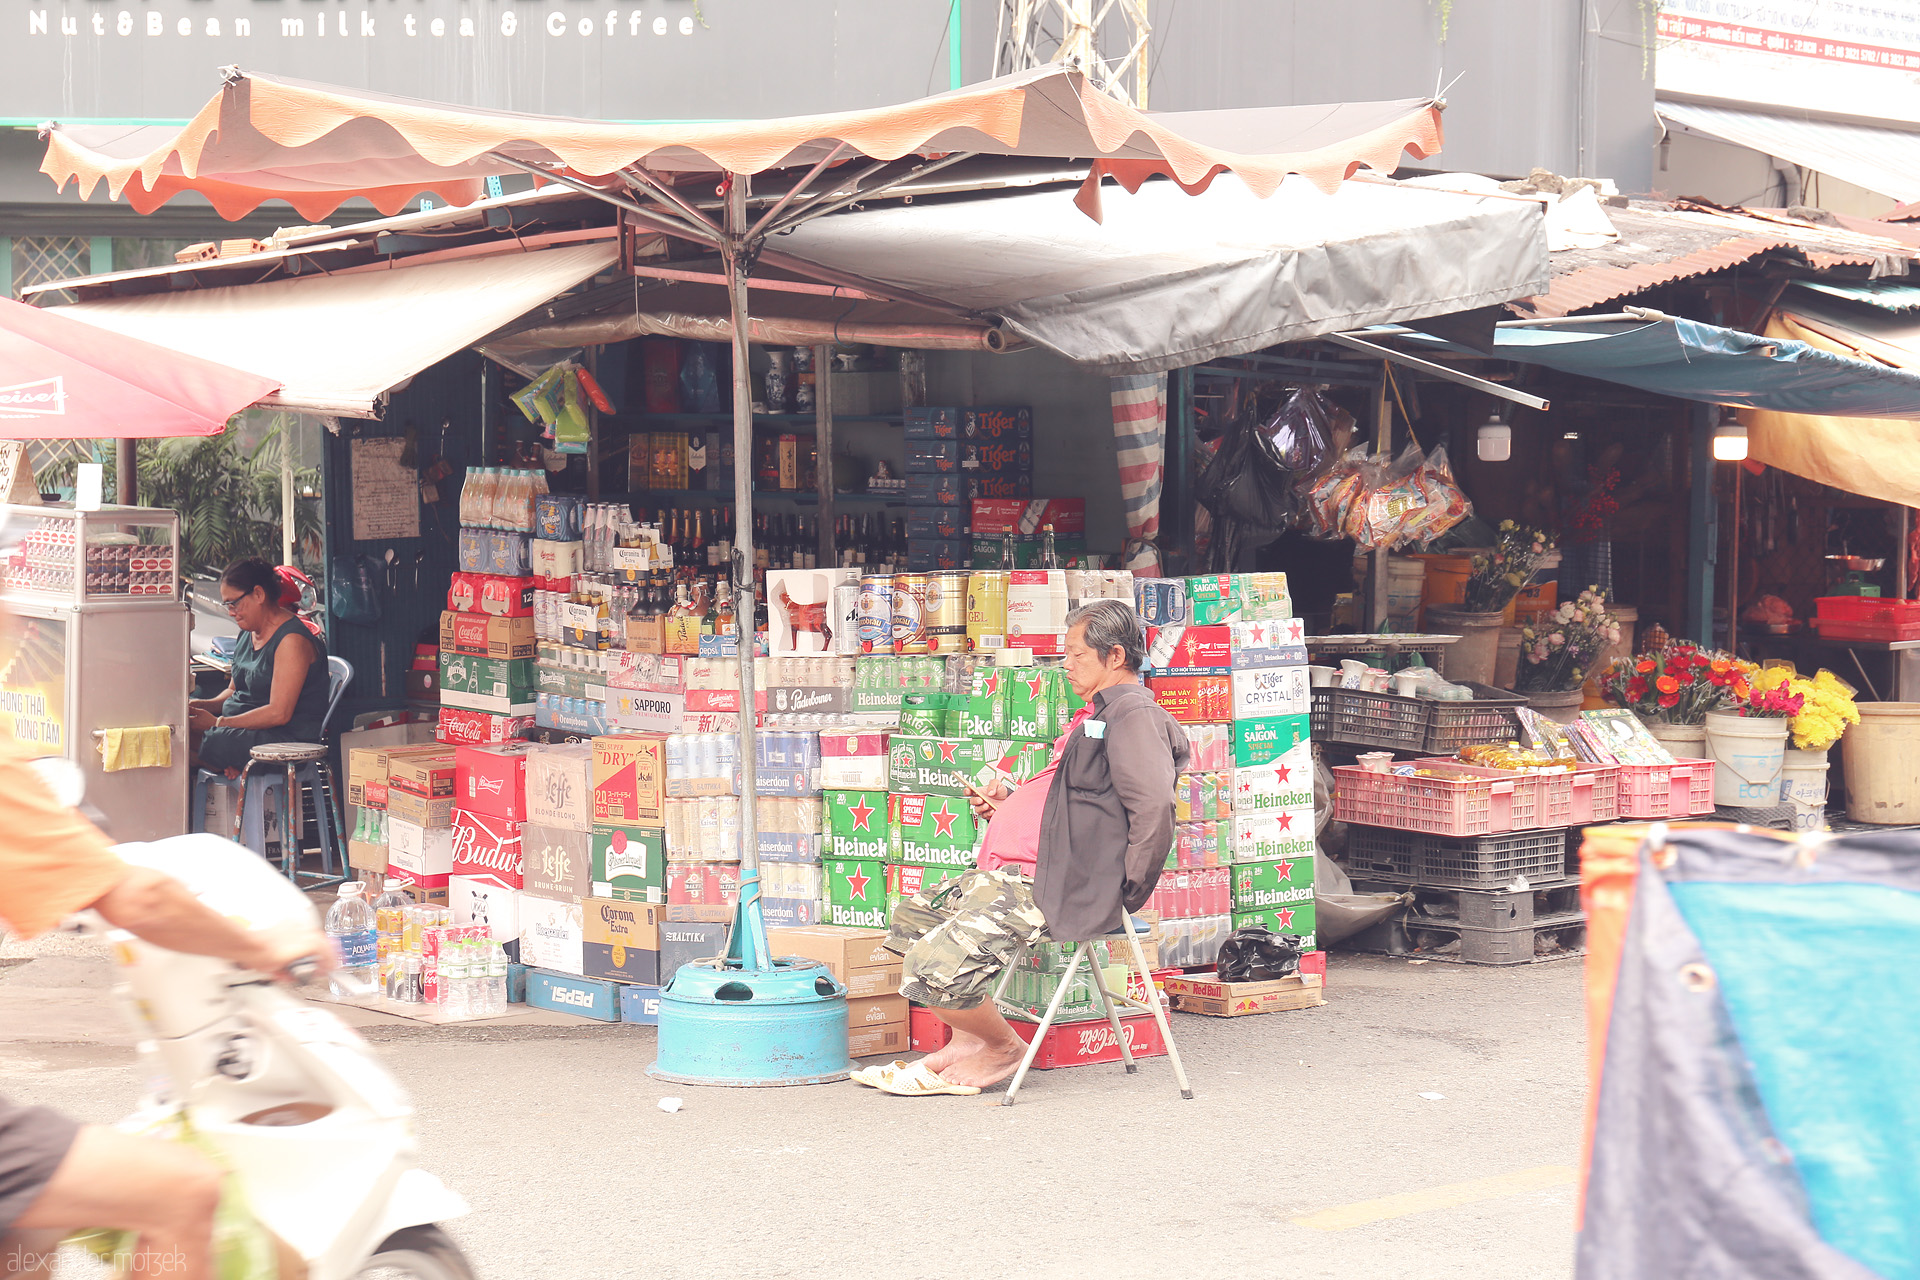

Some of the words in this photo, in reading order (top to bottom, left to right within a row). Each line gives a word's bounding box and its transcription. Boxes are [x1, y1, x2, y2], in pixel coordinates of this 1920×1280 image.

[29, 10, 251, 36] Nut&Bean
[281, 11, 376, 37] milk
[405, 12, 476, 37] tea
[500, 12, 518, 37] &
[546, 12, 694, 37] Coffee
[978, 411, 1015, 437] Tiger
[934, 425, 952, 437] Tiger
[979, 444, 1016, 471] Tiger
[936, 459, 954, 471] Tiger
[981, 477, 1017, 497] Tiger
[937, 492, 956, 504] Tiger
[973, 545, 997, 554] SAIGON
[1193, 583, 1218, 593] SAIGON
[458, 625, 484, 641] Coca-Cola
[700, 646, 718, 656] pepsi
[1262, 672, 1283, 688] Tiger
[1246, 690, 1291, 704] CRYSTAL
[634, 698, 671, 714] SAPPORO
[448, 716, 484, 740] Coca-Cola
[1255, 723, 1265, 731] BIA
[1244, 730, 1277, 742] SAIGON
[1248, 742, 1275, 751] SPECIAL
[544, 772, 572, 809] Leffe
[696, 782, 722, 791] БАЛТИКА
[903, 797, 925, 806] FORMAT
[1253, 791, 1312, 809] Heineken
[903, 806, 922, 814] SPECIAL
[1255, 839, 1314, 857] Heineken
[541, 845, 572, 883] Leffe
[902, 867, 922, 877] FORMAT
[902, 876, 920, 885] SPECIAL
[1254, 886, 1315, 906] Heineken
[600, 904, 636, 924] Corona
[610, 922, 629, 934] Extra
[672, 931, 705, 943] BALTIKA
[869, 952, 890, 962] evian
[1192, 983, 1206, 996] Red
[1207, 985, 1222, 998] Bull
[551, 985, 595, 1009] PEPSI
[1056, 1004, 1088, 1015] Heineken
[865, 1011, 886, 1022] evian
